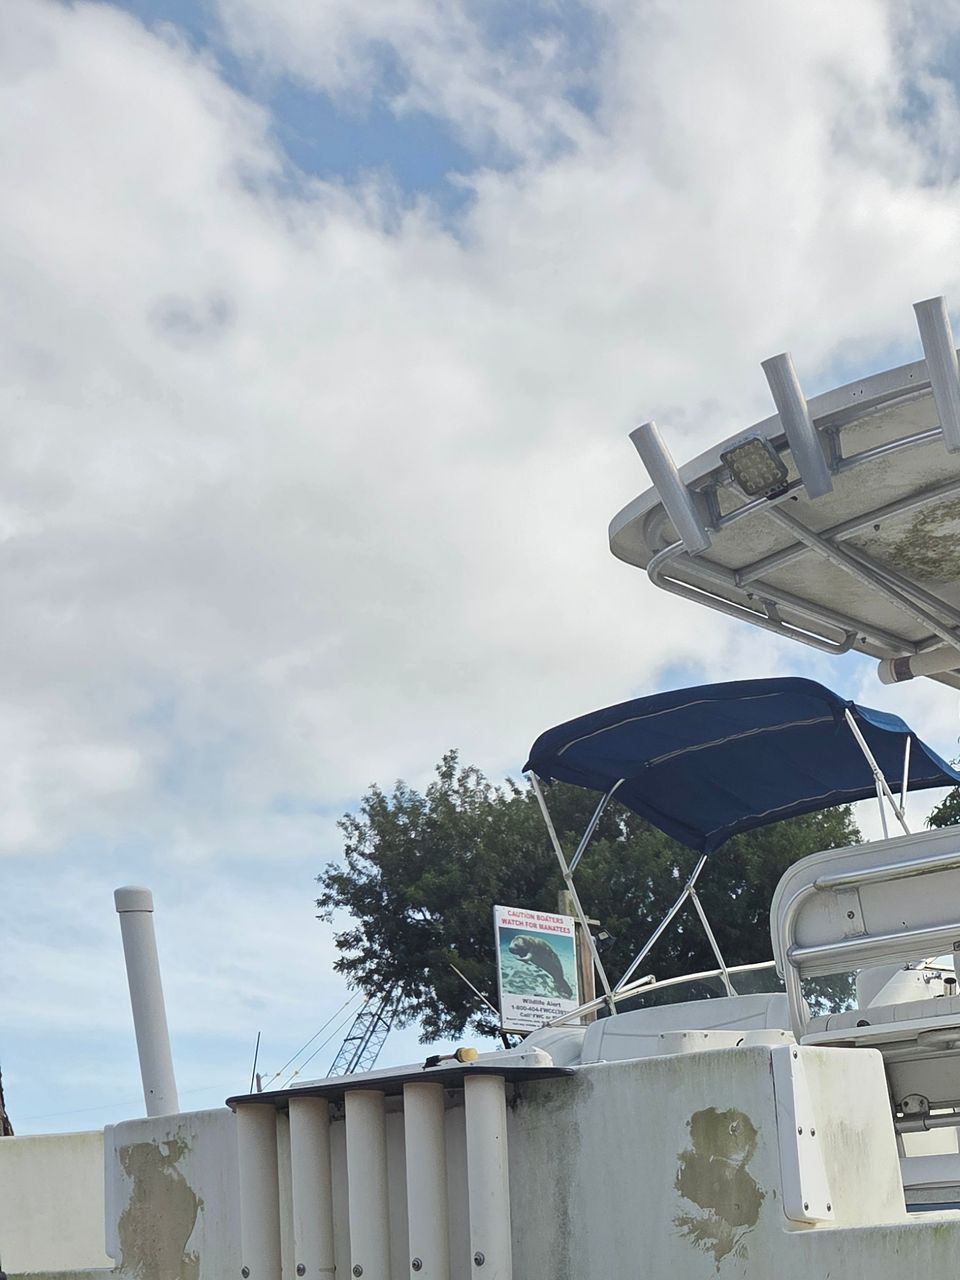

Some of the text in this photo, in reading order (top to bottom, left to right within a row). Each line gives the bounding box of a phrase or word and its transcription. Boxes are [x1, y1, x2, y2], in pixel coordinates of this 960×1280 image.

[507, 910, 564, 924] CAUTION BOATERS
[501, 918, 524, 927] WATCH
[539, 923, 571, 934] MANATEES
[522, 998, 545, 1006] Wildlife
